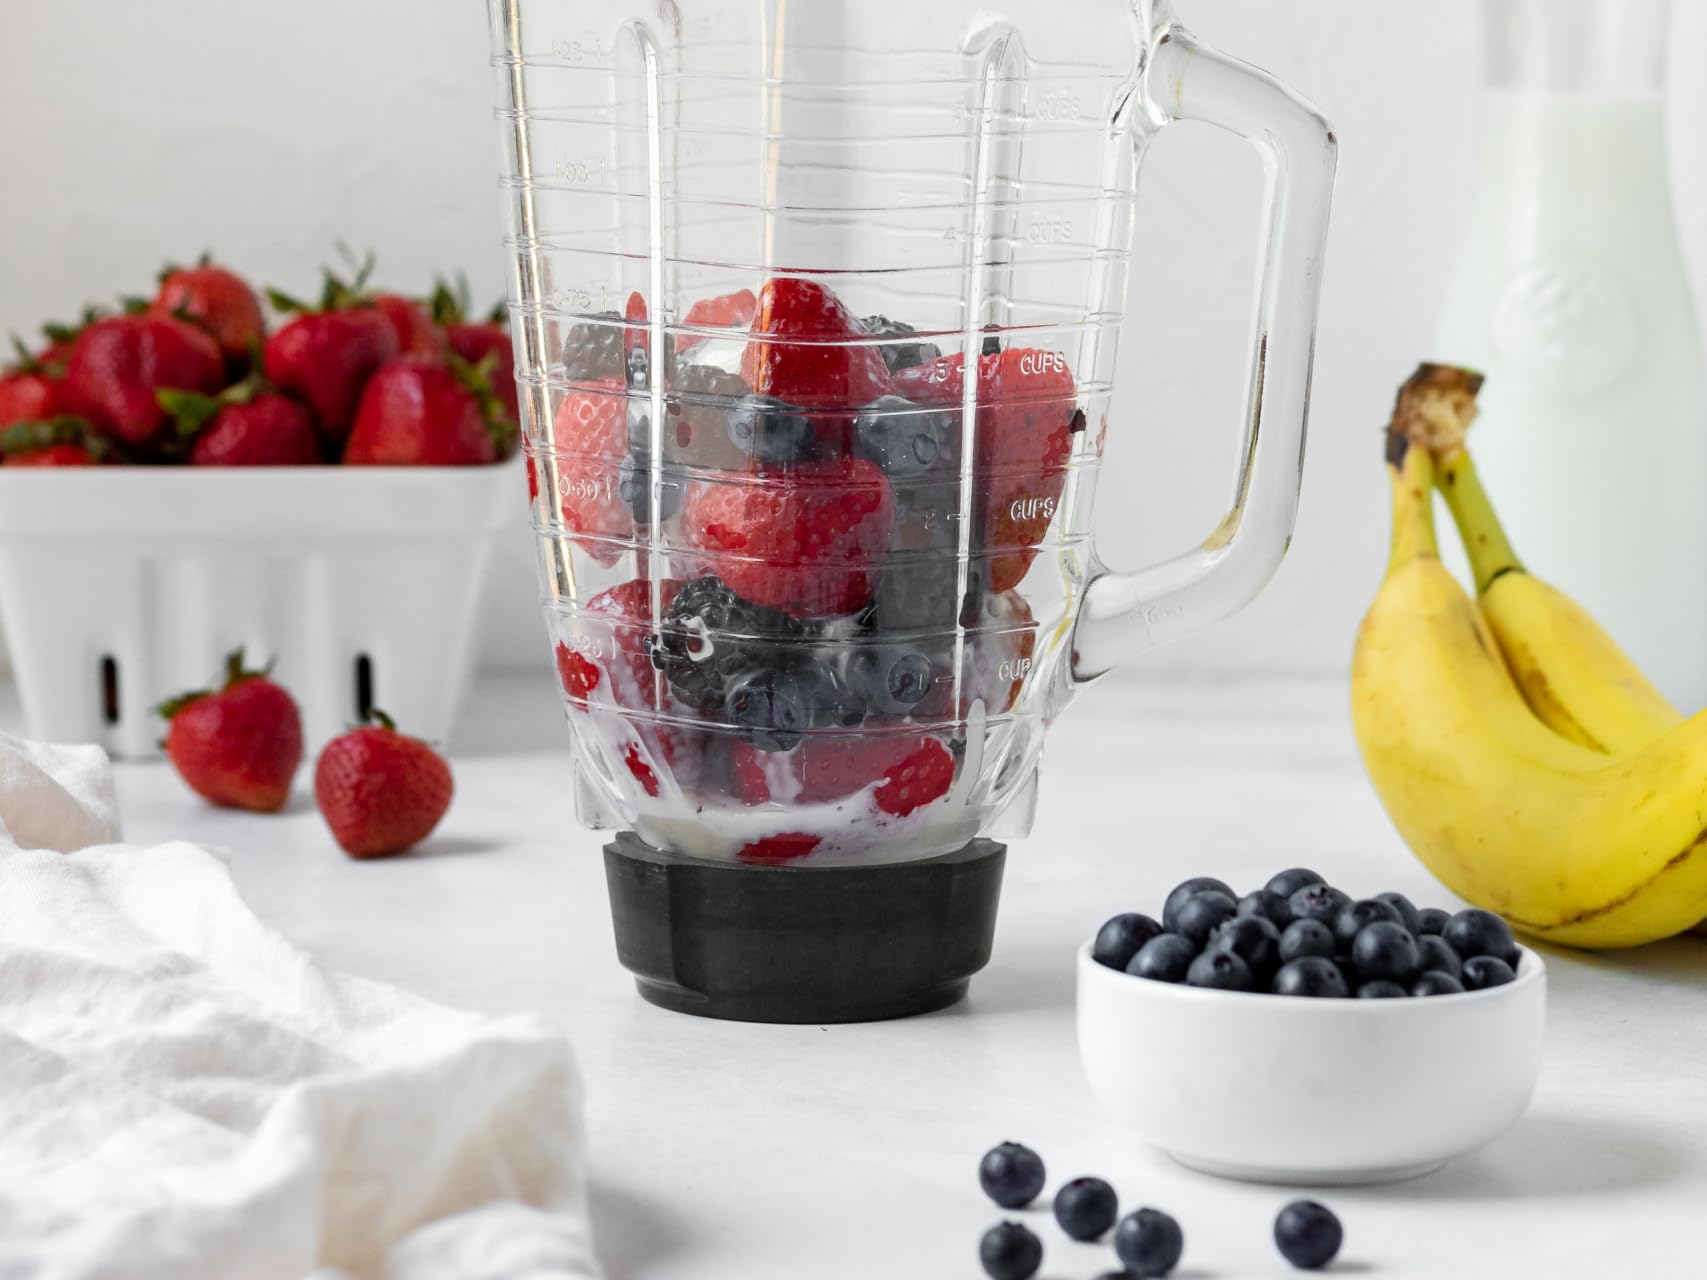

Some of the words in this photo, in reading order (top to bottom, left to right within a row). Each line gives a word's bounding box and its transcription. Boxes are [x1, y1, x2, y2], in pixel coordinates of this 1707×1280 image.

[1028, 221, 1073, 241] CUPS
[1020, 351, 1065, 375] CUPS
[1010, 497, 1054, 521] CUPS
[998, 657, 1032, 681] CUP
